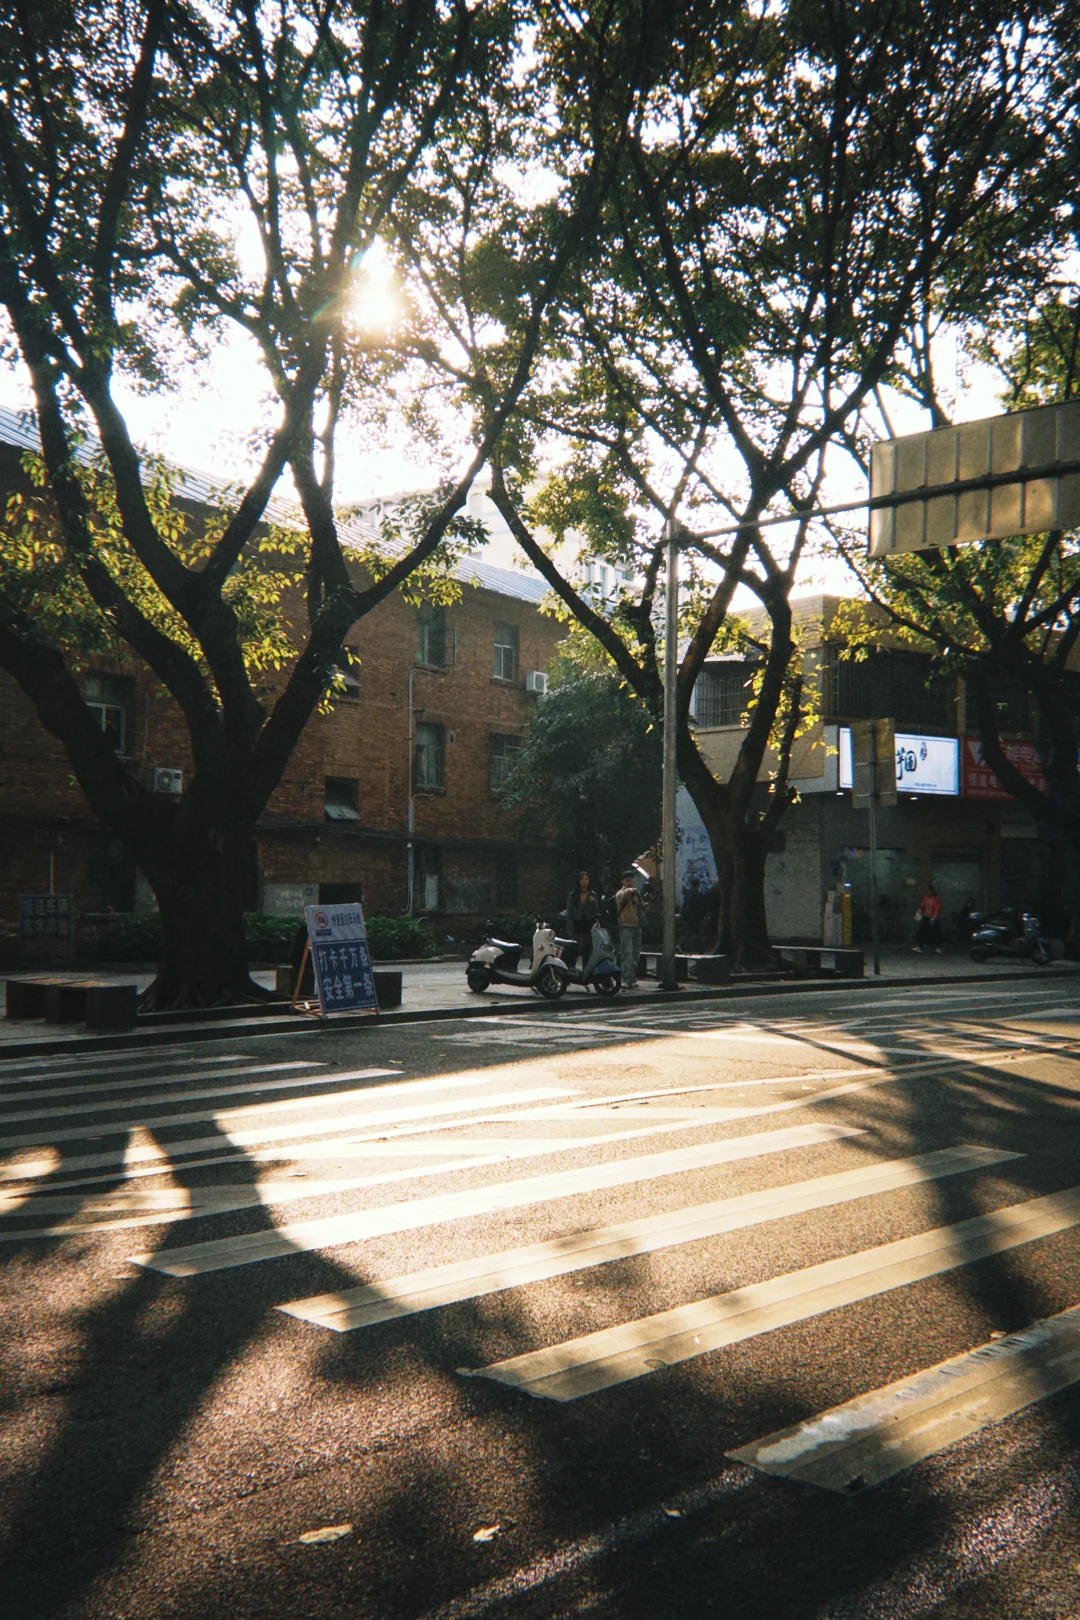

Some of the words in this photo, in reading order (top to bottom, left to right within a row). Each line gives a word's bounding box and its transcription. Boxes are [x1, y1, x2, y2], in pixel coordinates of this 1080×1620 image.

[319, 945, 369, 971] 打卡千万条
[323, 972, 374, 1001] 安全第一条
